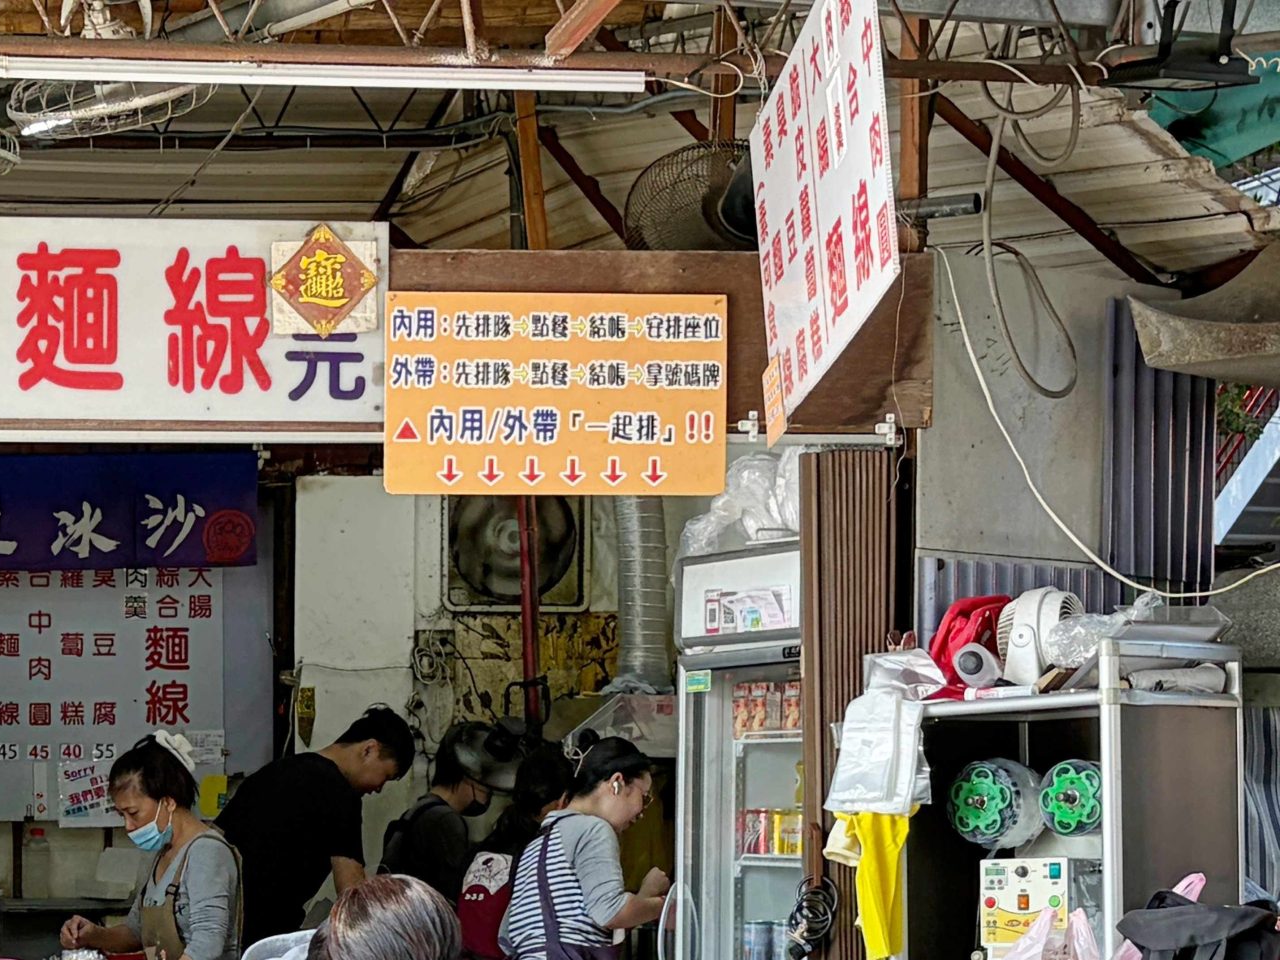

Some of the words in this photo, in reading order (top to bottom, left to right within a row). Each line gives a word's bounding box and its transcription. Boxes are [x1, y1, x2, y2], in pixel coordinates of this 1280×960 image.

[285, 333, 366, 401] 元
[156, 567, 180, 619] 綜合
[188, 567, 212, 619] 大腸
[145, 625, 190, 726] 麵線
[29, 745, 49, 759] 45
[62, 744, 81, 759] 40
[94, 743, 114, 759] 55
[64, 765, 95, 780] Sorry
